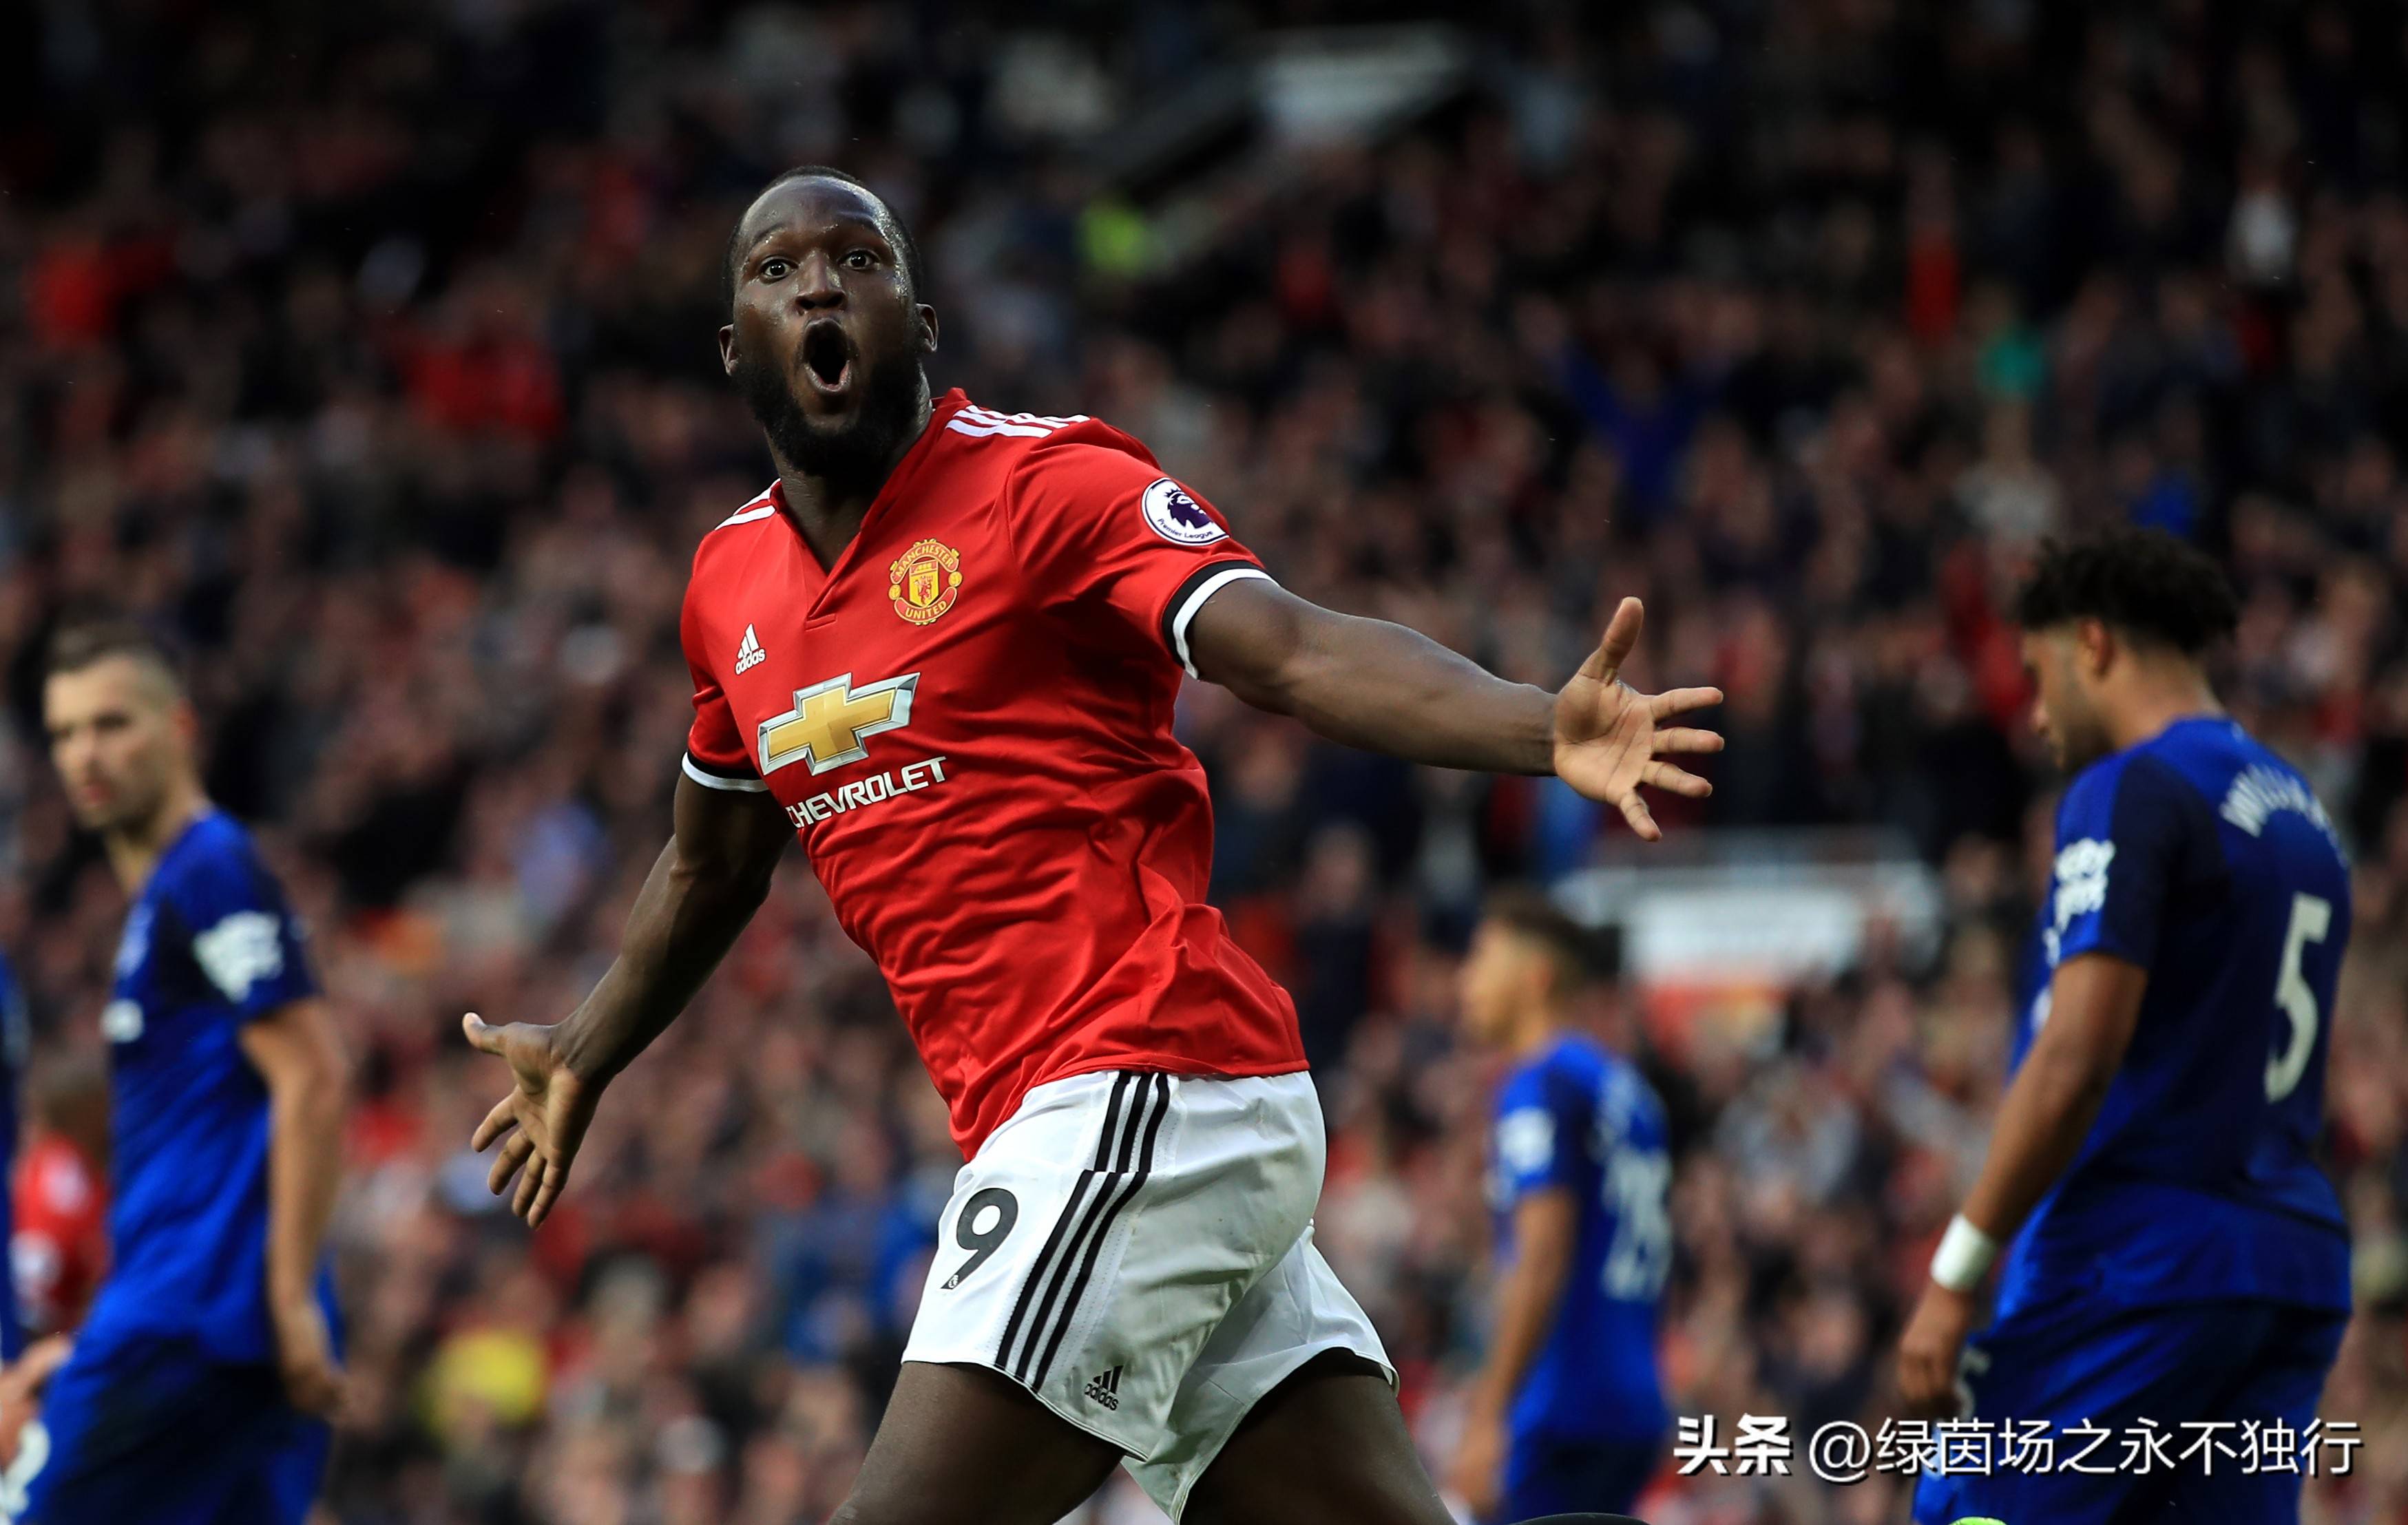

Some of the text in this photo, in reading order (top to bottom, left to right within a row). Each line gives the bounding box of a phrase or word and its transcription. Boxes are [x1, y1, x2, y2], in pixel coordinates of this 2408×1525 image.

[1158, 518, 1213, 539] Premier League
[895, 545, 954, 578] MANCHESTER
[905, 600, 947, 619] UNITED
[735, 648, 766, 675] adidas
[2263, 891, 2332, 1103] 5
[940, 1187, 1019, 1290] 9
[1084, 1383, 1119, 1411] adidas
